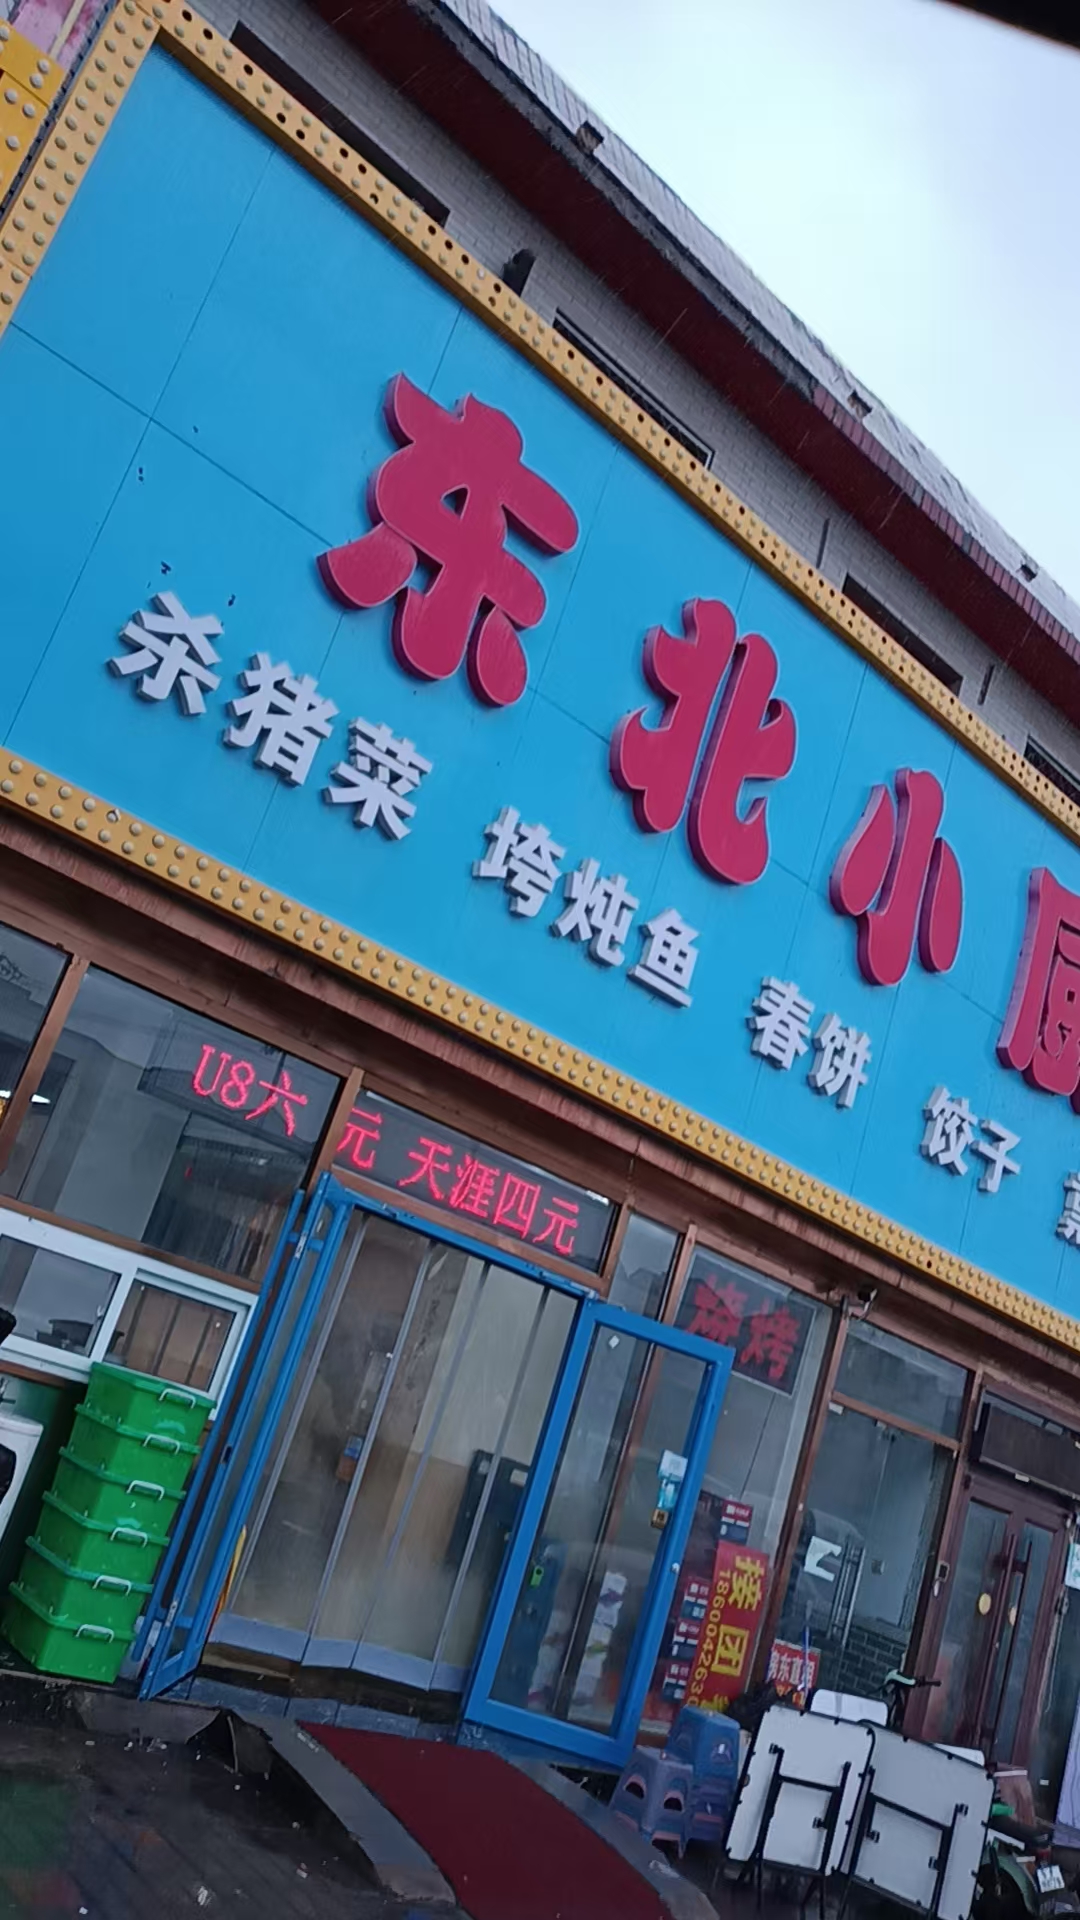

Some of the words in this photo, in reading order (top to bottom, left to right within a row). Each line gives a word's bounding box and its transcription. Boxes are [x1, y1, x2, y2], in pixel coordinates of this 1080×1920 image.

[106, 590, 433, 840] 杀猪菜
[472, 805, 700, 1008] 垮炖鱼
[745, 976, 871, 1109] 春饼
[920, 1086, 1020, 1193] 饺子
[397, 1135, 580, 1256] 天涯四元
